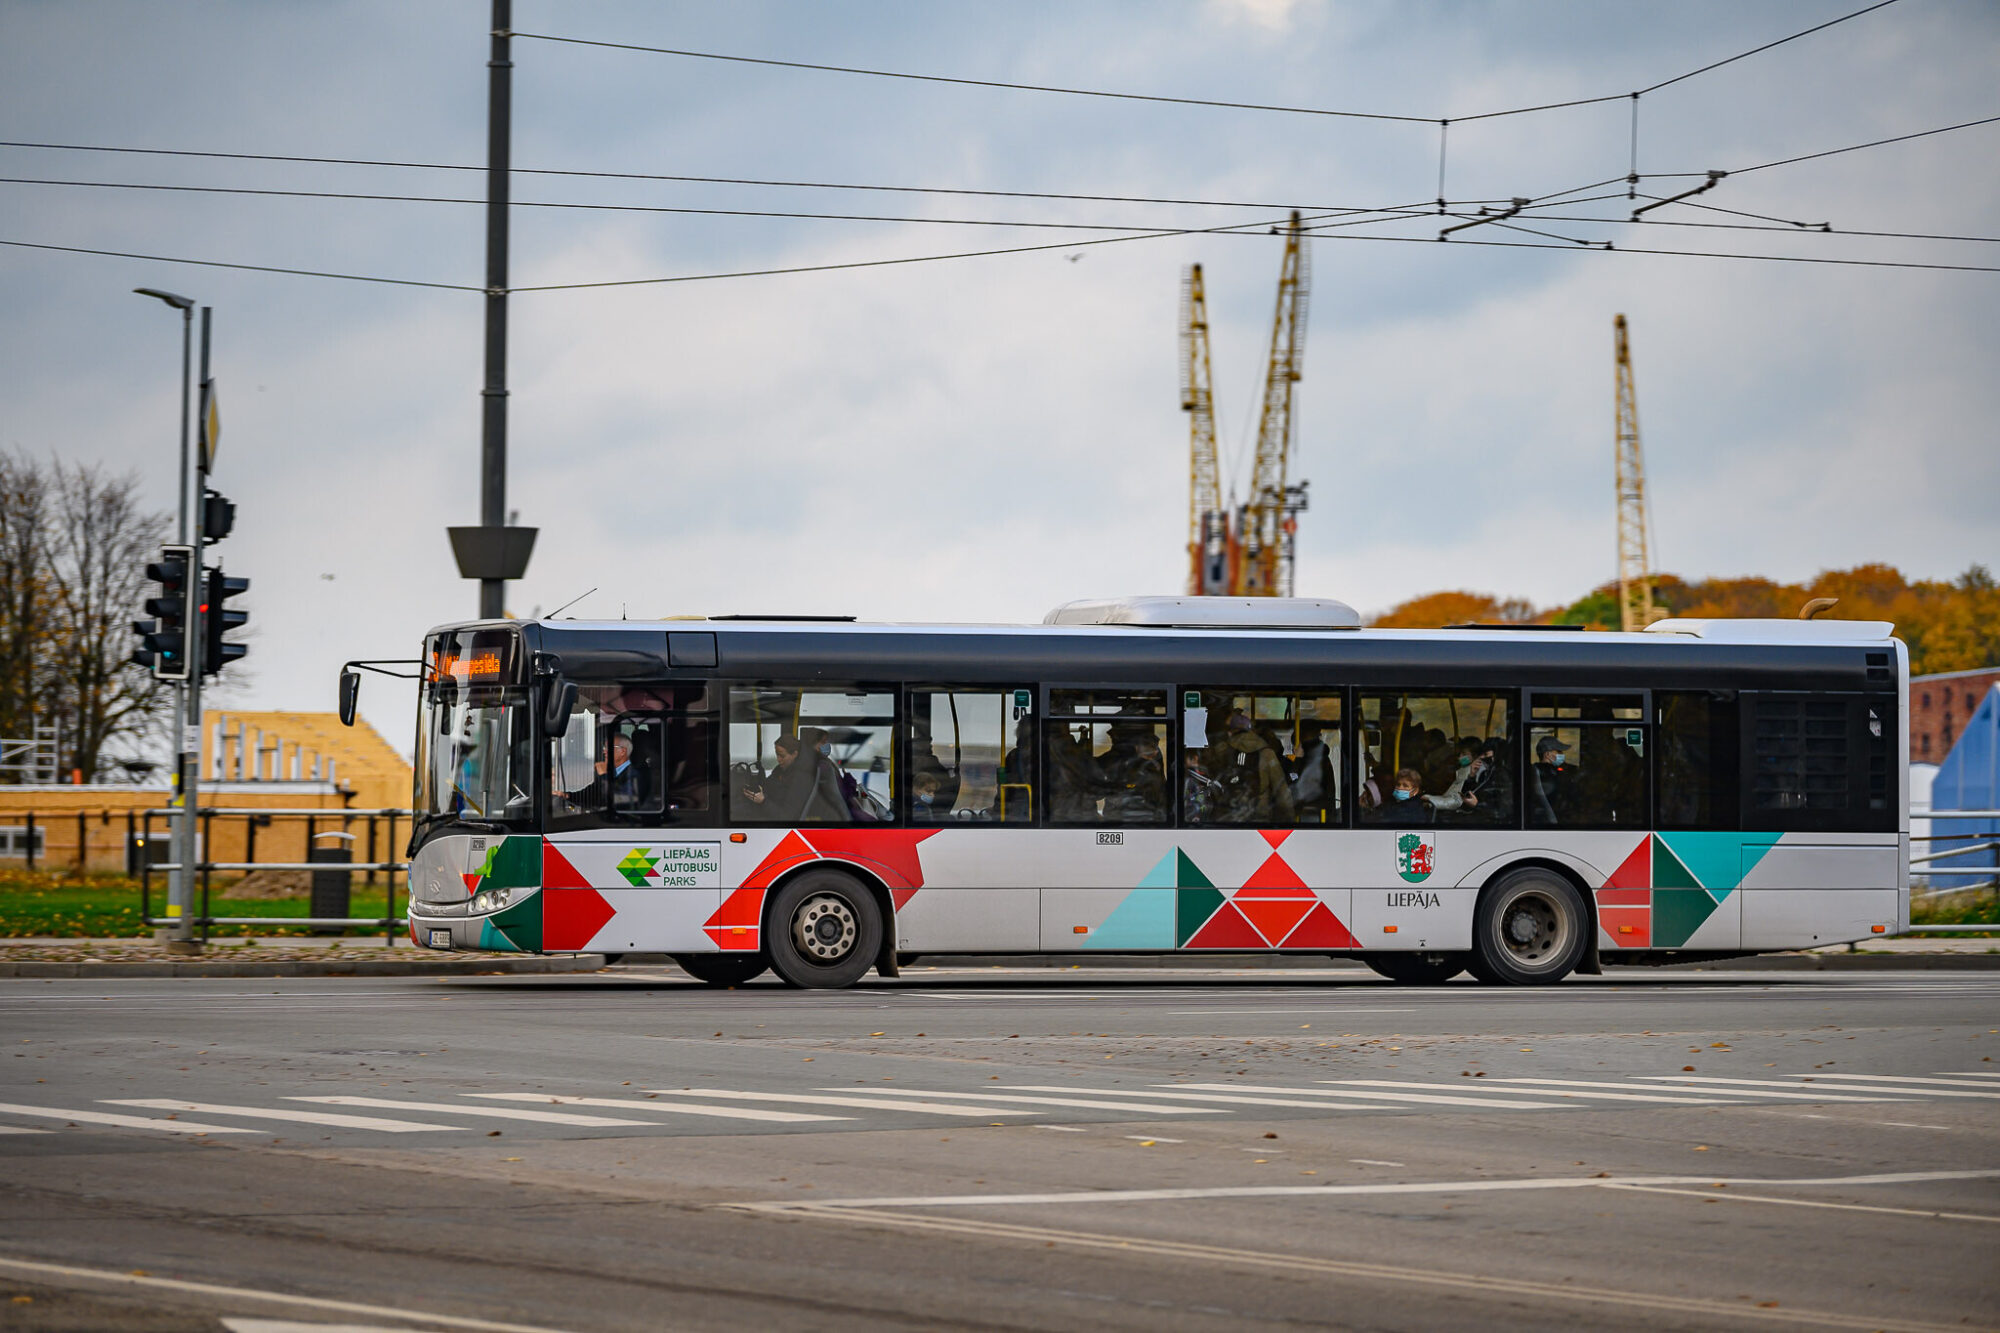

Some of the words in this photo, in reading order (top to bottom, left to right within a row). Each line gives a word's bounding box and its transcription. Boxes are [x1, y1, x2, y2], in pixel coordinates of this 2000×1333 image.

[1099, 833, 1121, 844] 8209
[663, 848, 710, 859] LIEPĀJAS
[663, 862, 717, 873] AUTOBUSU
[663, 876, 696, 887] PARKS
[1387, 890, 1441, 909] LIEPĀJA
